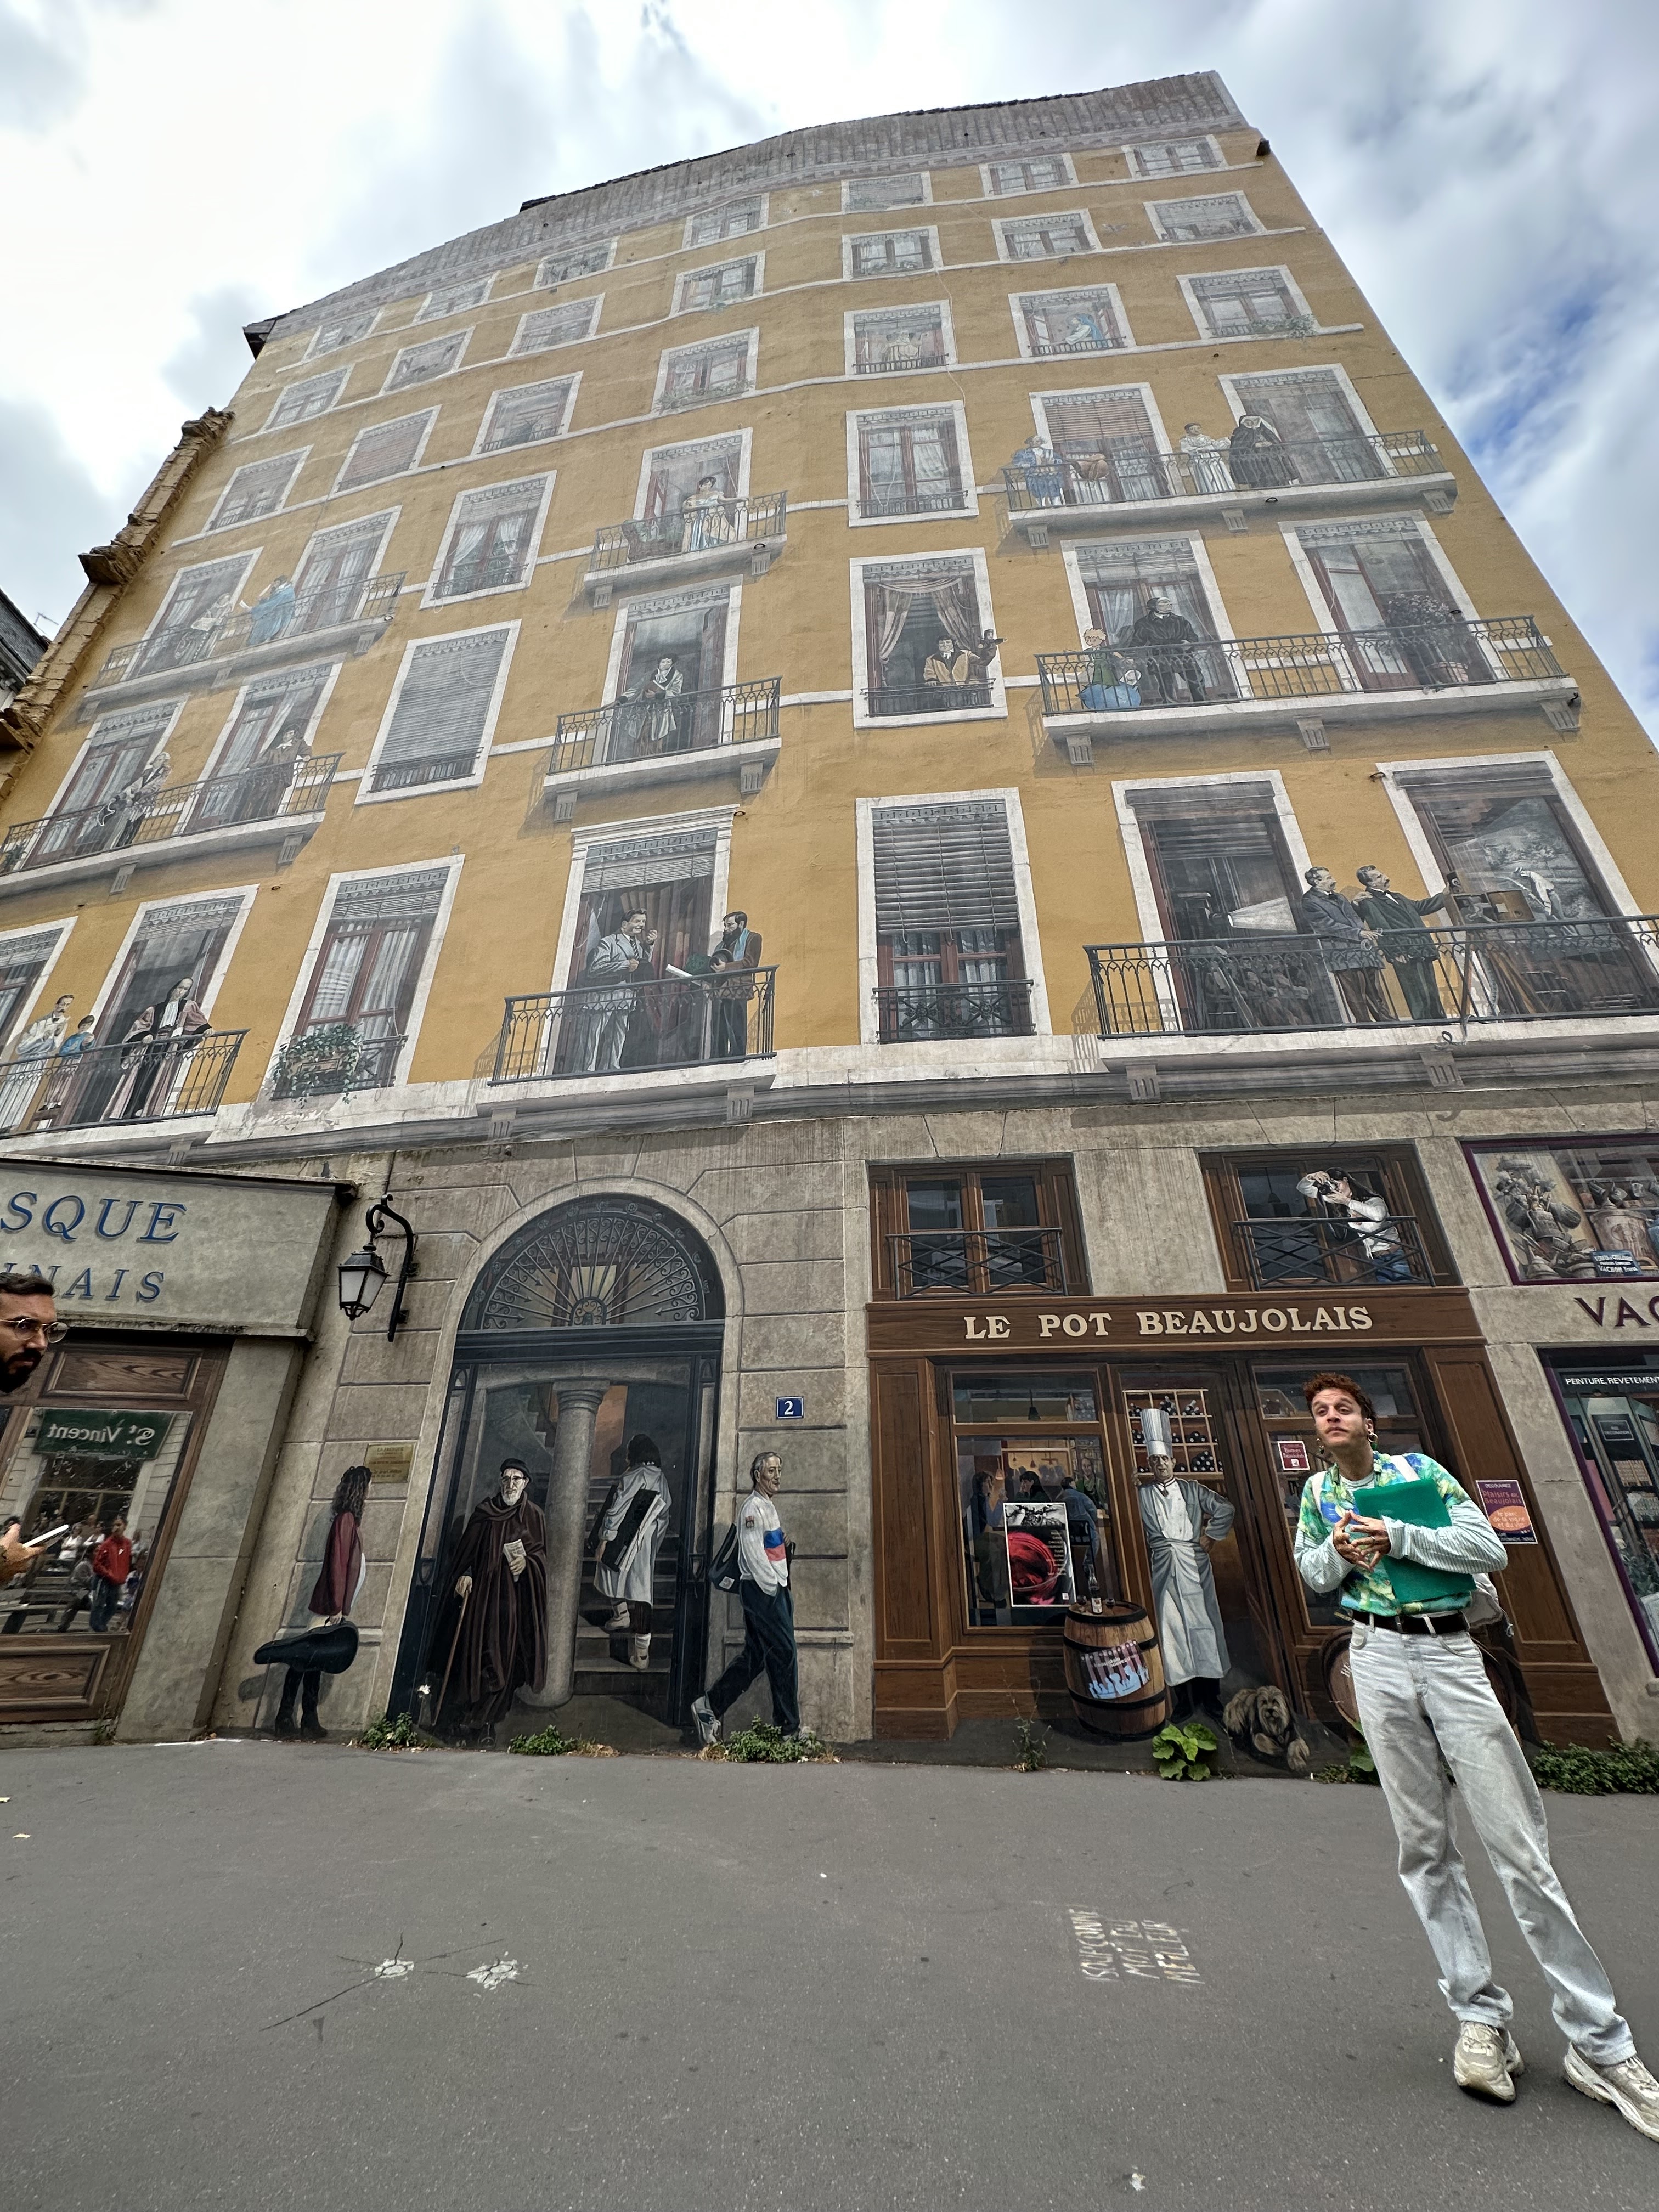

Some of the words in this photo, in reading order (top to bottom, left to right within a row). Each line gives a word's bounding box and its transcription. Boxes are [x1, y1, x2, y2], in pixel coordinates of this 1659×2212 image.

[1, 1192, 188, 1242] SQUE
[964, 1316, 1011, 1339] LE
[1038, 1313, 1112, 1336] POT
[1136, 1306, 1373, 1335] BEAUJOLAIS
[785, 1401, 794, 1415] 2
